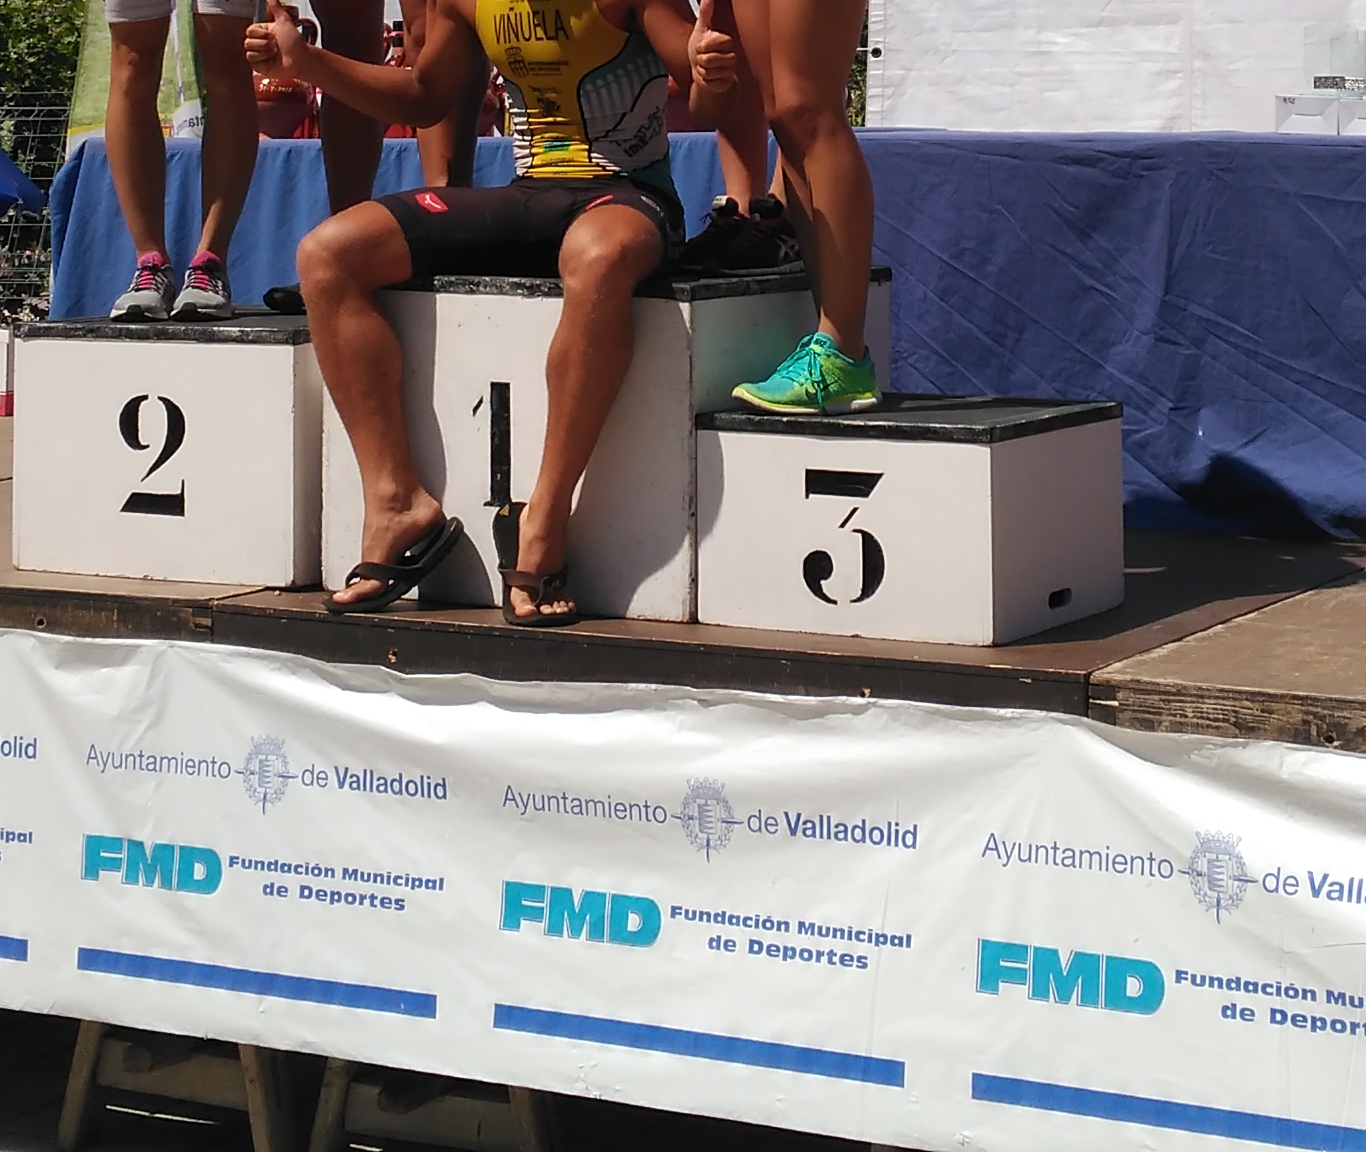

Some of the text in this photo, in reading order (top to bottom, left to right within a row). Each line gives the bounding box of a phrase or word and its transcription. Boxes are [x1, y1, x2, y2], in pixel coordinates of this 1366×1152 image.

[494, 7, 569, 44] VIÑUELA
[118, 394, 186, 517] 2
[472, 381, 512, 507] 1
[802, 469, 885, 604] 3
[86, 745, 447, 800] Ayuntamiento de Valladolid
[503, 785, 918, 850] Ayuntamiento de Valladolid
[81, 834, 223, 896] FMD
[229, 856, 444, 891] Fundación Municipal
[981, 832, 1174, 880] Ayuntamiento
[1262, 867, 1299, 896] de
[262, 882, 406, 911] de Deportes
[499, 879, 663, 948] FMD
[670, 905, 912, 949] Fundación Municipal
[707, 935, 869, 970] de Deportes
[975, 938, 1165, 1016] FMD
[1174, 969, 1317, 1002] Fundación
[1221, 1003, 1255, 1022] de
